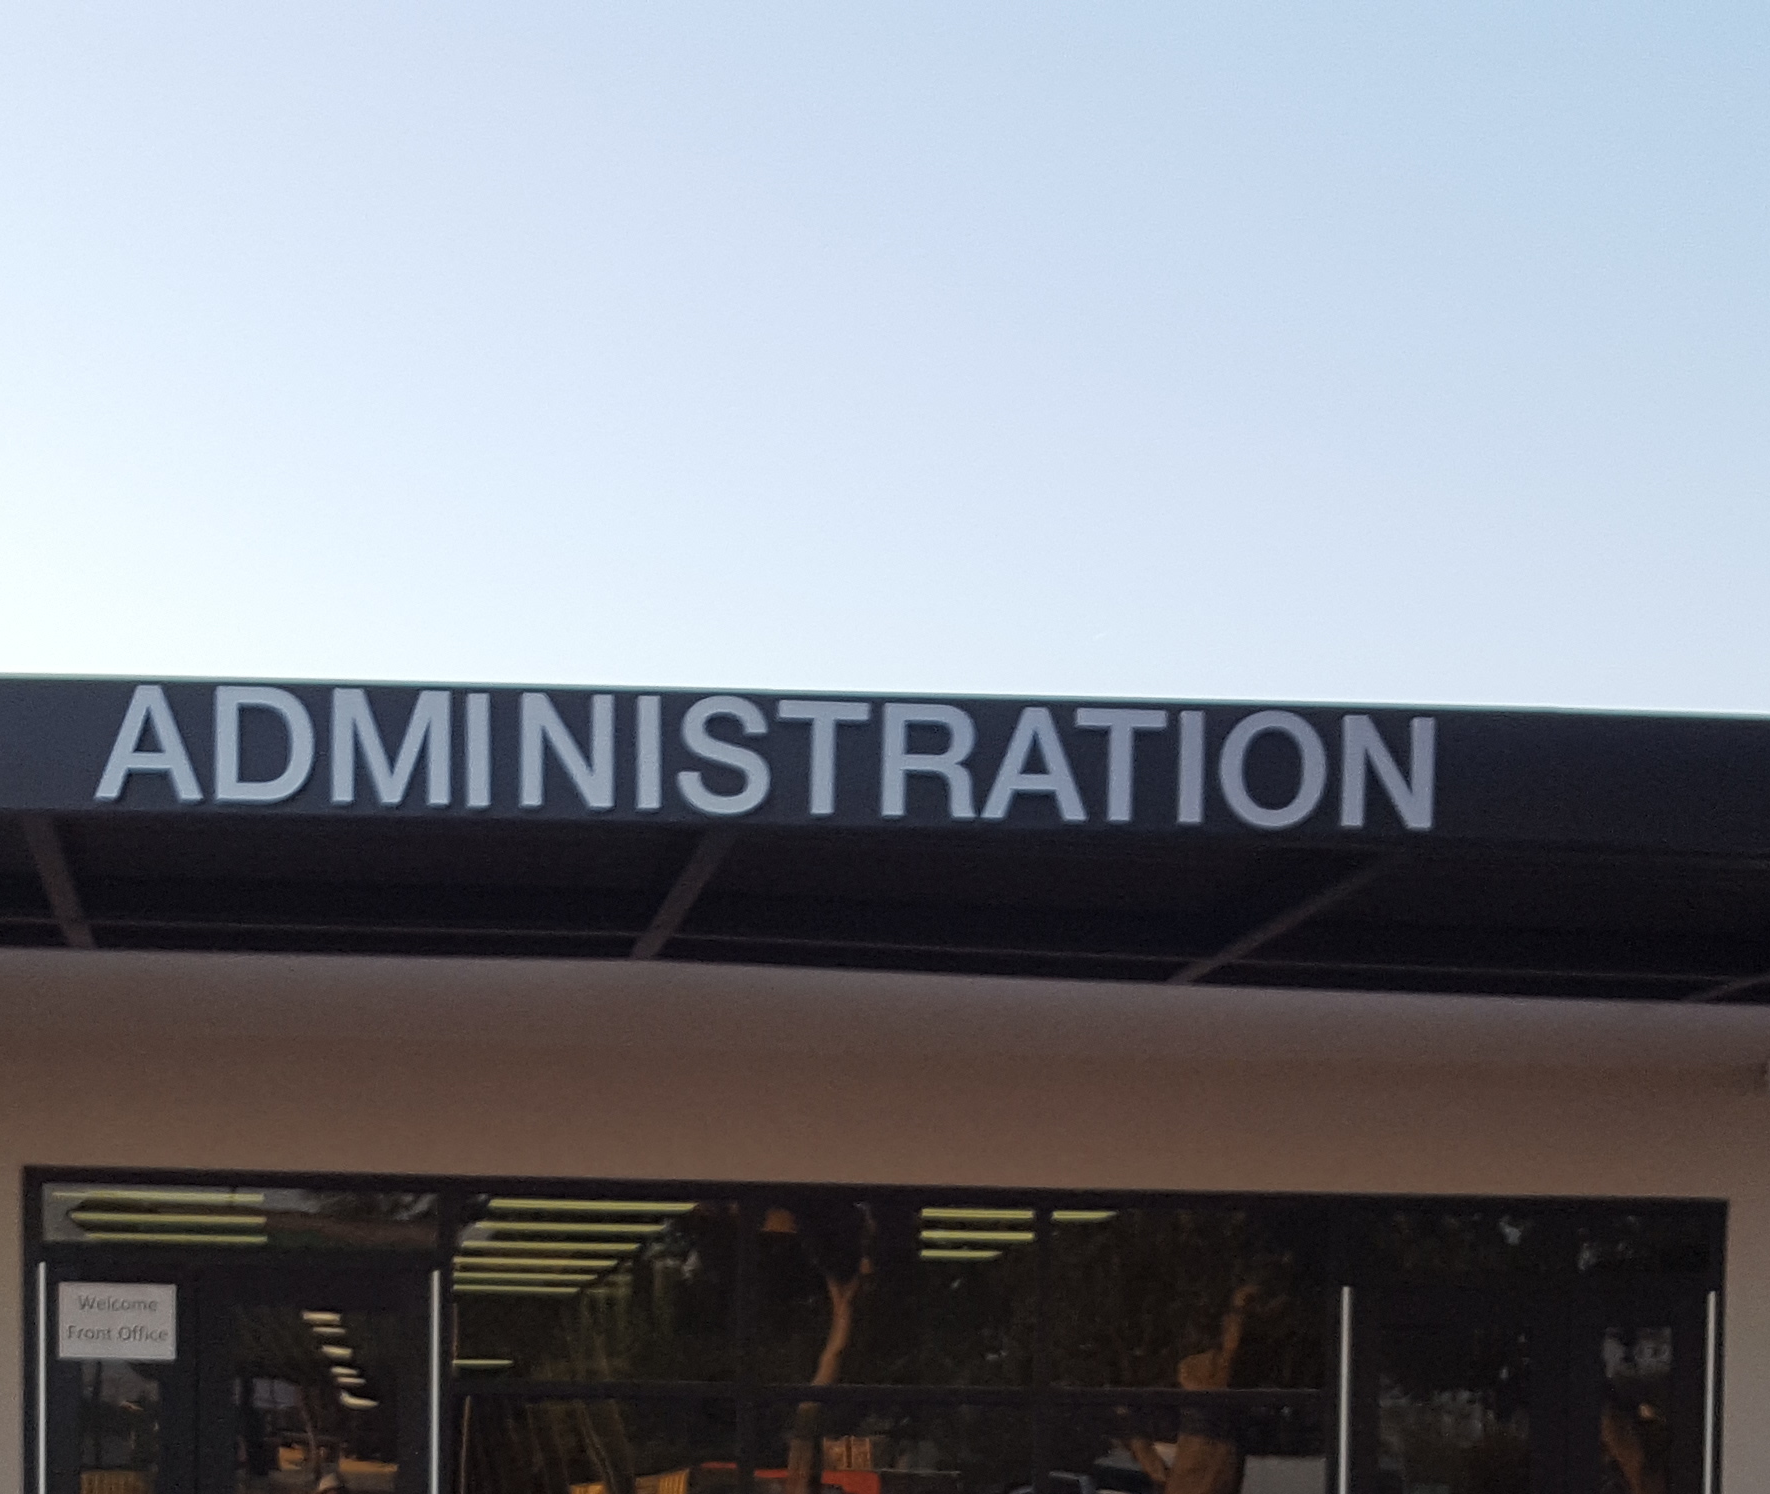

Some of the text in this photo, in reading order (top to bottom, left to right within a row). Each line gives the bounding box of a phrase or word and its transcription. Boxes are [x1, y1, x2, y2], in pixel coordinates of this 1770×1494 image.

[94, 682, 1435, 831] ADMINISTRATION
[77, 1294, 159, 1312] Welcome
[67, 1324, 170, 1342] Front Office
